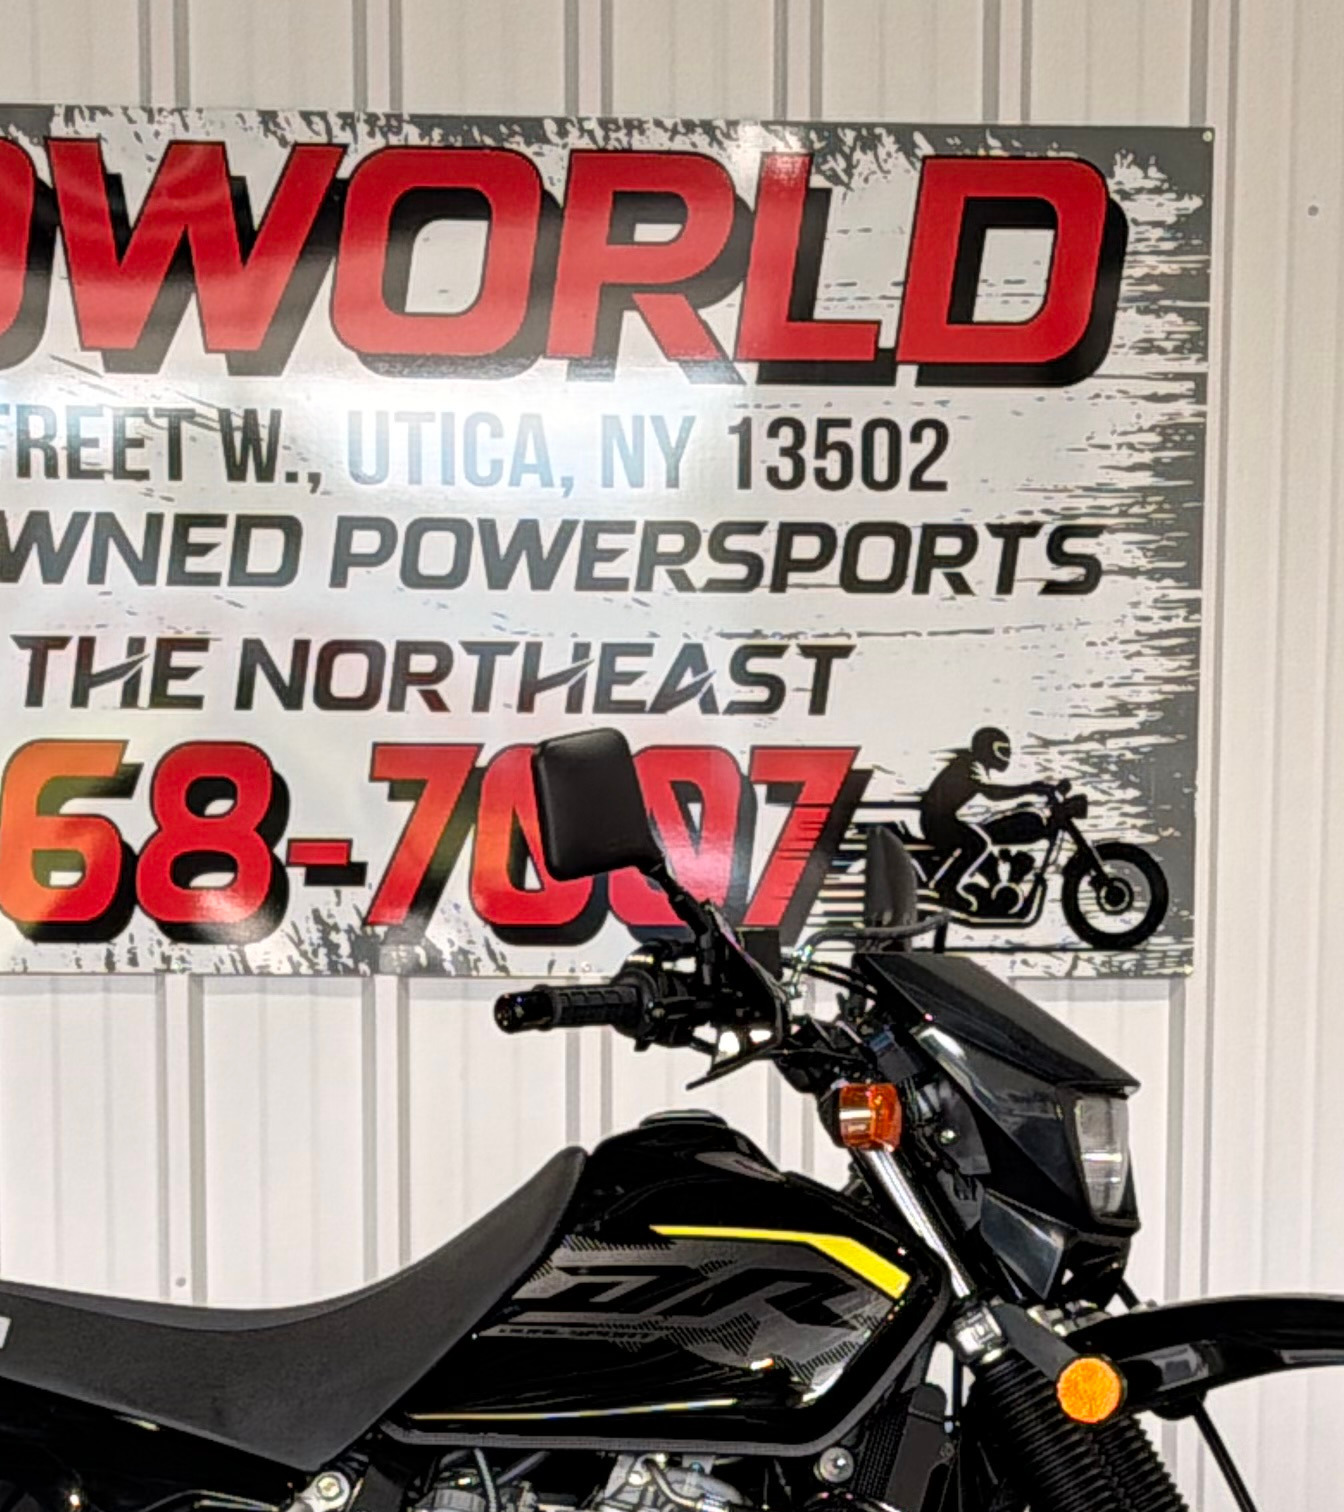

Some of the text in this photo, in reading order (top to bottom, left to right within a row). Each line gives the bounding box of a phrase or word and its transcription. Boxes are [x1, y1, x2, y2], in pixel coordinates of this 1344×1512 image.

[217, 406, 324, 494] W.,
[348, 411, 573, 497] UTICA,
[599, 414, 698, 490] NY
[728, 416, 948, 494] 13502
[329, 516, 1105, 596] POWERSPORTS
[11, 634, 211, 712] THE
[232, 640, 856, 716] NORTHEAST
